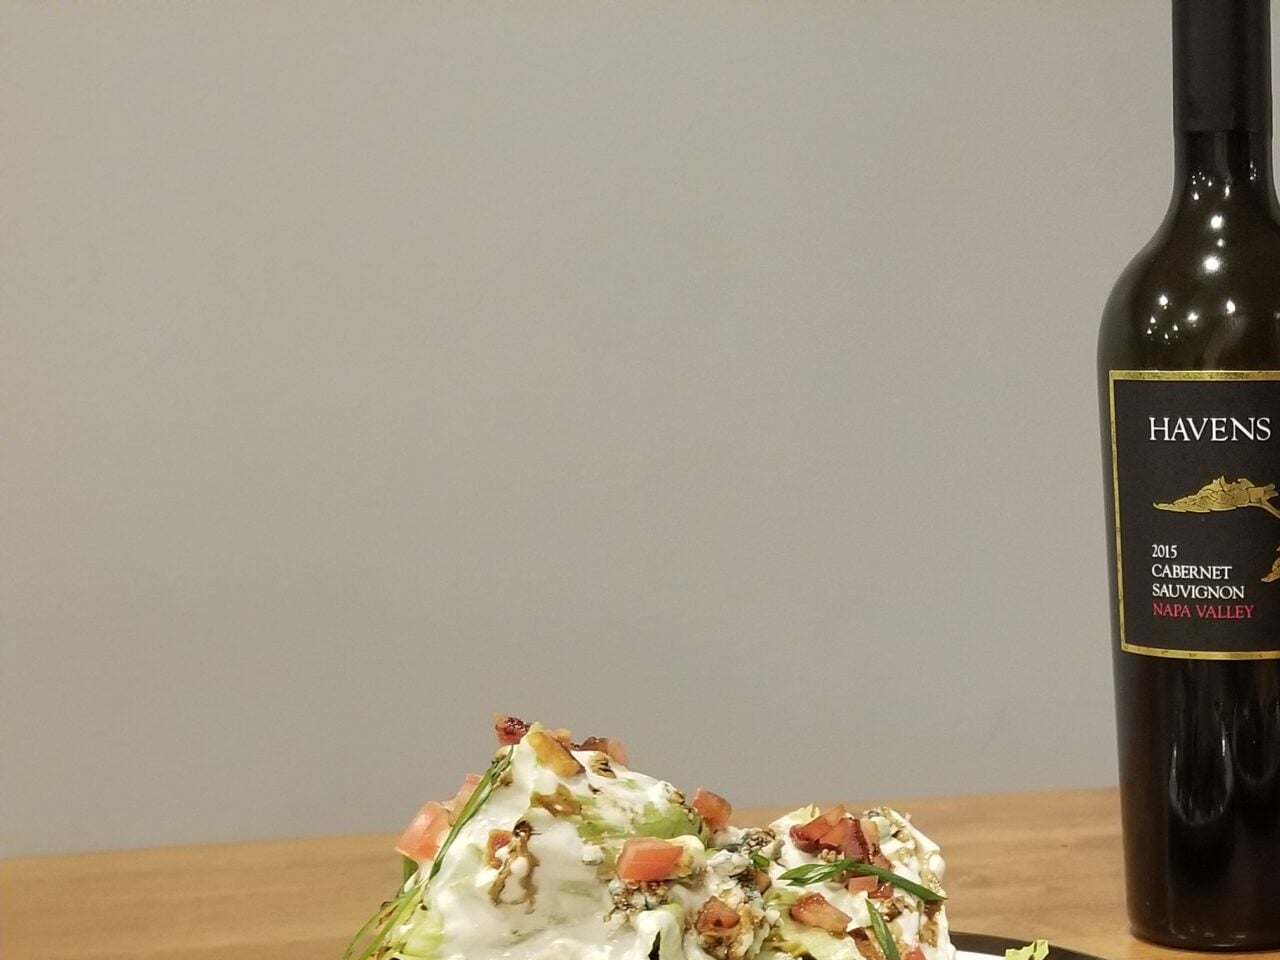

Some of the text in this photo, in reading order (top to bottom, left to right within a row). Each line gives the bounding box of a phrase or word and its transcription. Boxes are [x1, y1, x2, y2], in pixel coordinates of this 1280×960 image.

[1148, 416, 1272, 442] HAVENS
[1151, 544, 1178, 559] 2015
[1151, 563, 1233, 580] CABERNET
[1152, 583, 1245, 600] SAUVIGNON
[1152, 602, 1255, 619] NAPA VALLEY
